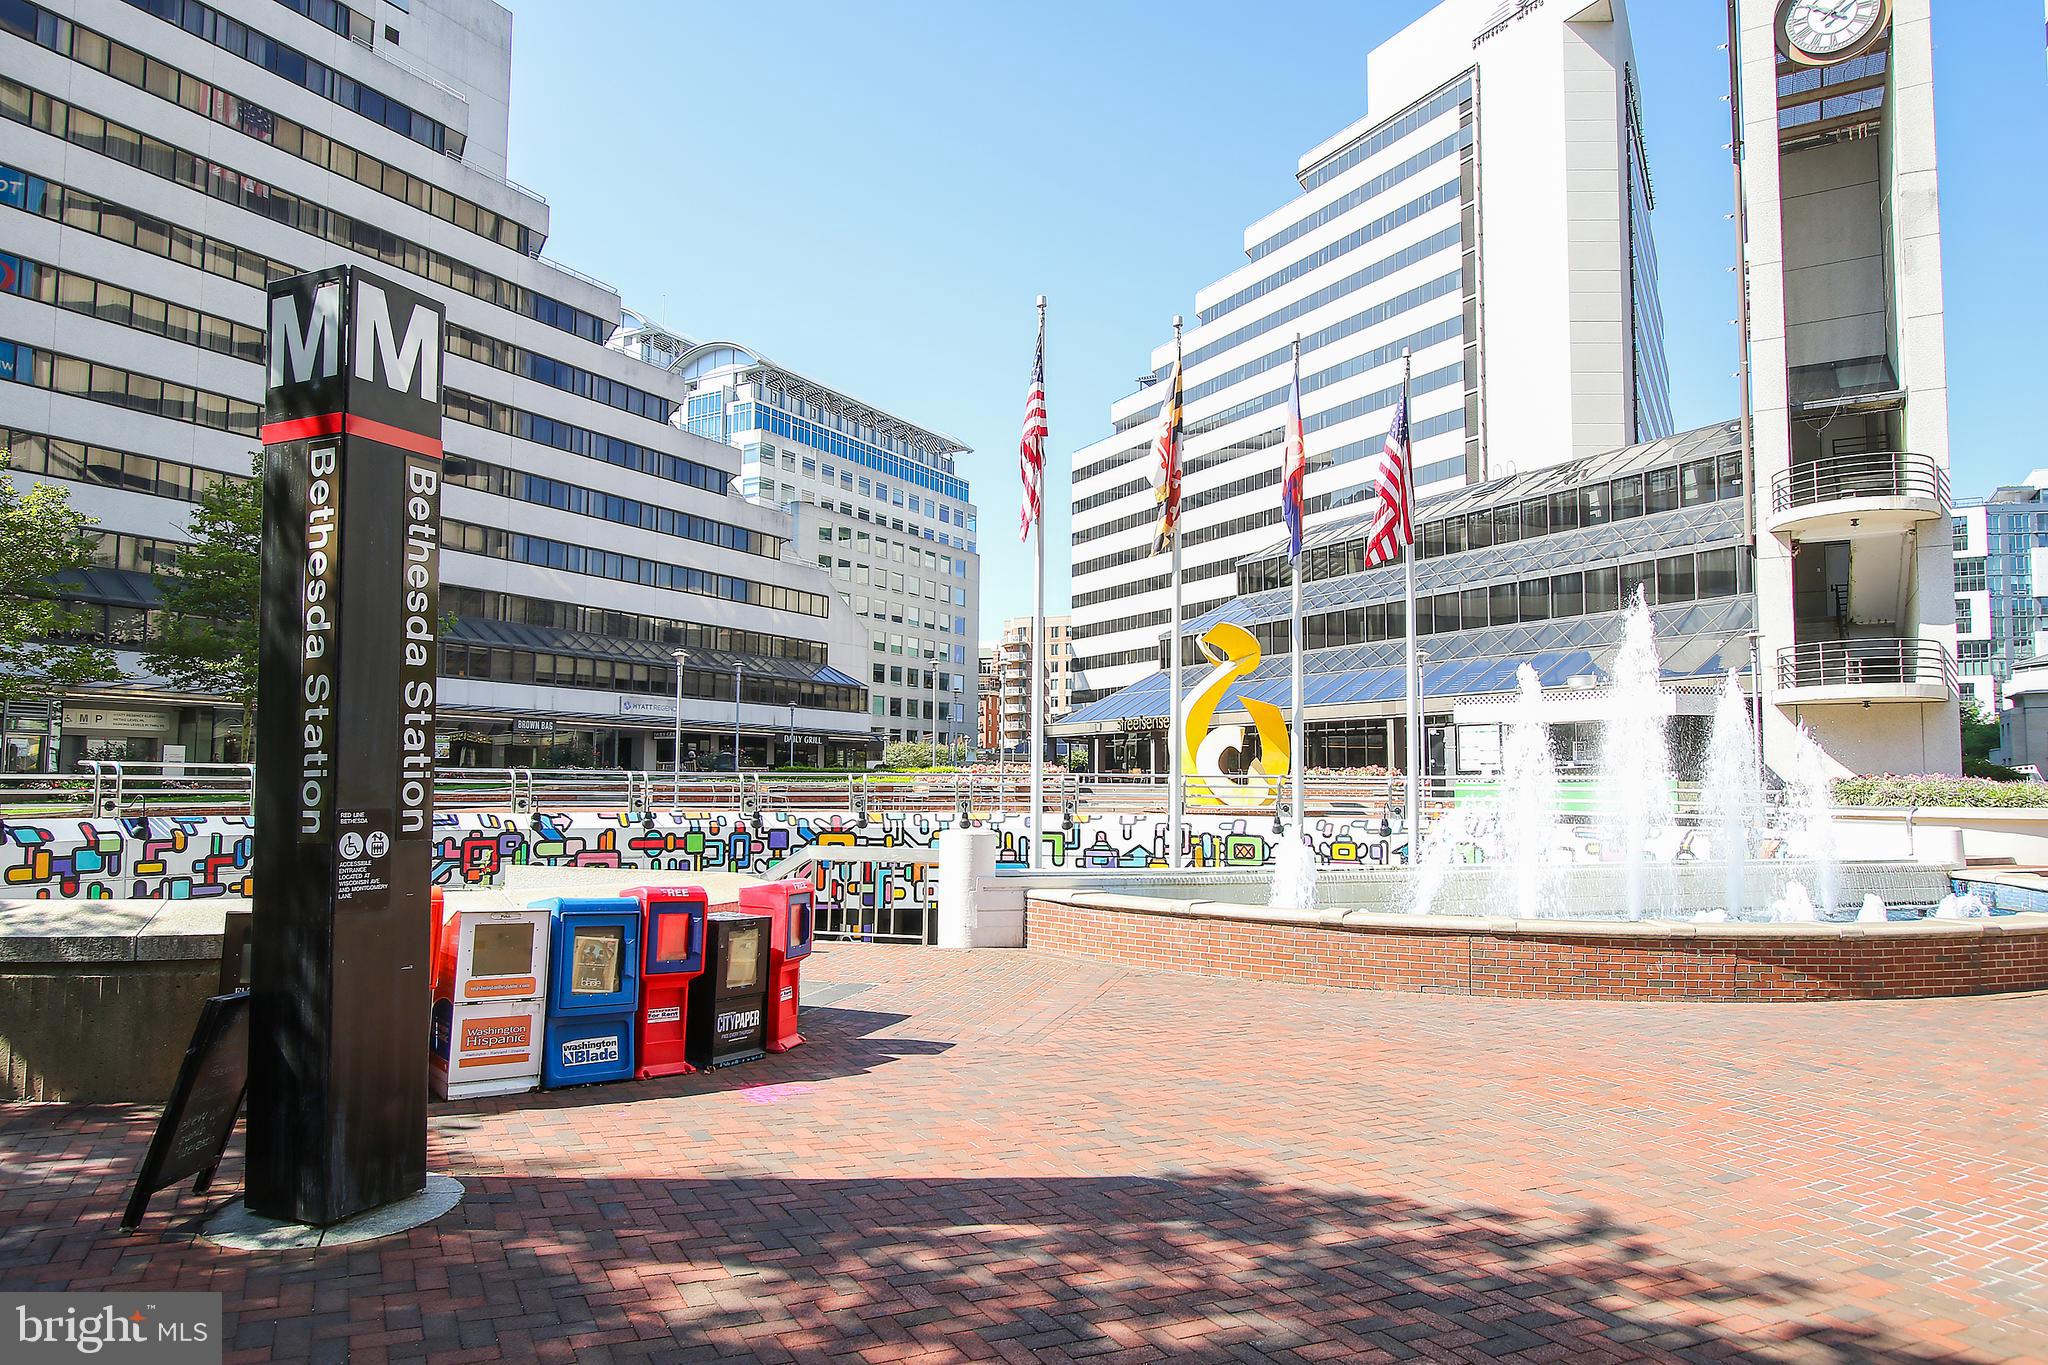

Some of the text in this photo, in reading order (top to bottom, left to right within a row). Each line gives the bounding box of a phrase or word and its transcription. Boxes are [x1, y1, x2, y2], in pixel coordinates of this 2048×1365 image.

[270, 282, 340, 389] M
[355, 280, 439, 404] M
[302, 447, 335, 834] Bethesda Station
[402, 465, 437, 832] Bethesda Station
[653, 704, 677, 712] REGENC
[79, 714, 103, 723] M P
[517, 719, 554, 731] BROWN BAG
[803, 735, 823, 745] GRILL
[339, 860, 372, 868] ACCESSIBLE
[351, 884, 389, 892] MONTGOMERY
[660, 888, 690, 897] FREE
[467, 1026, 526, 1036] Washington
[466, 1034, 526, 1047] Hispanic
[563, 1040, 617, 1052] washington
[575, 1048, 617, 1063] Blade
